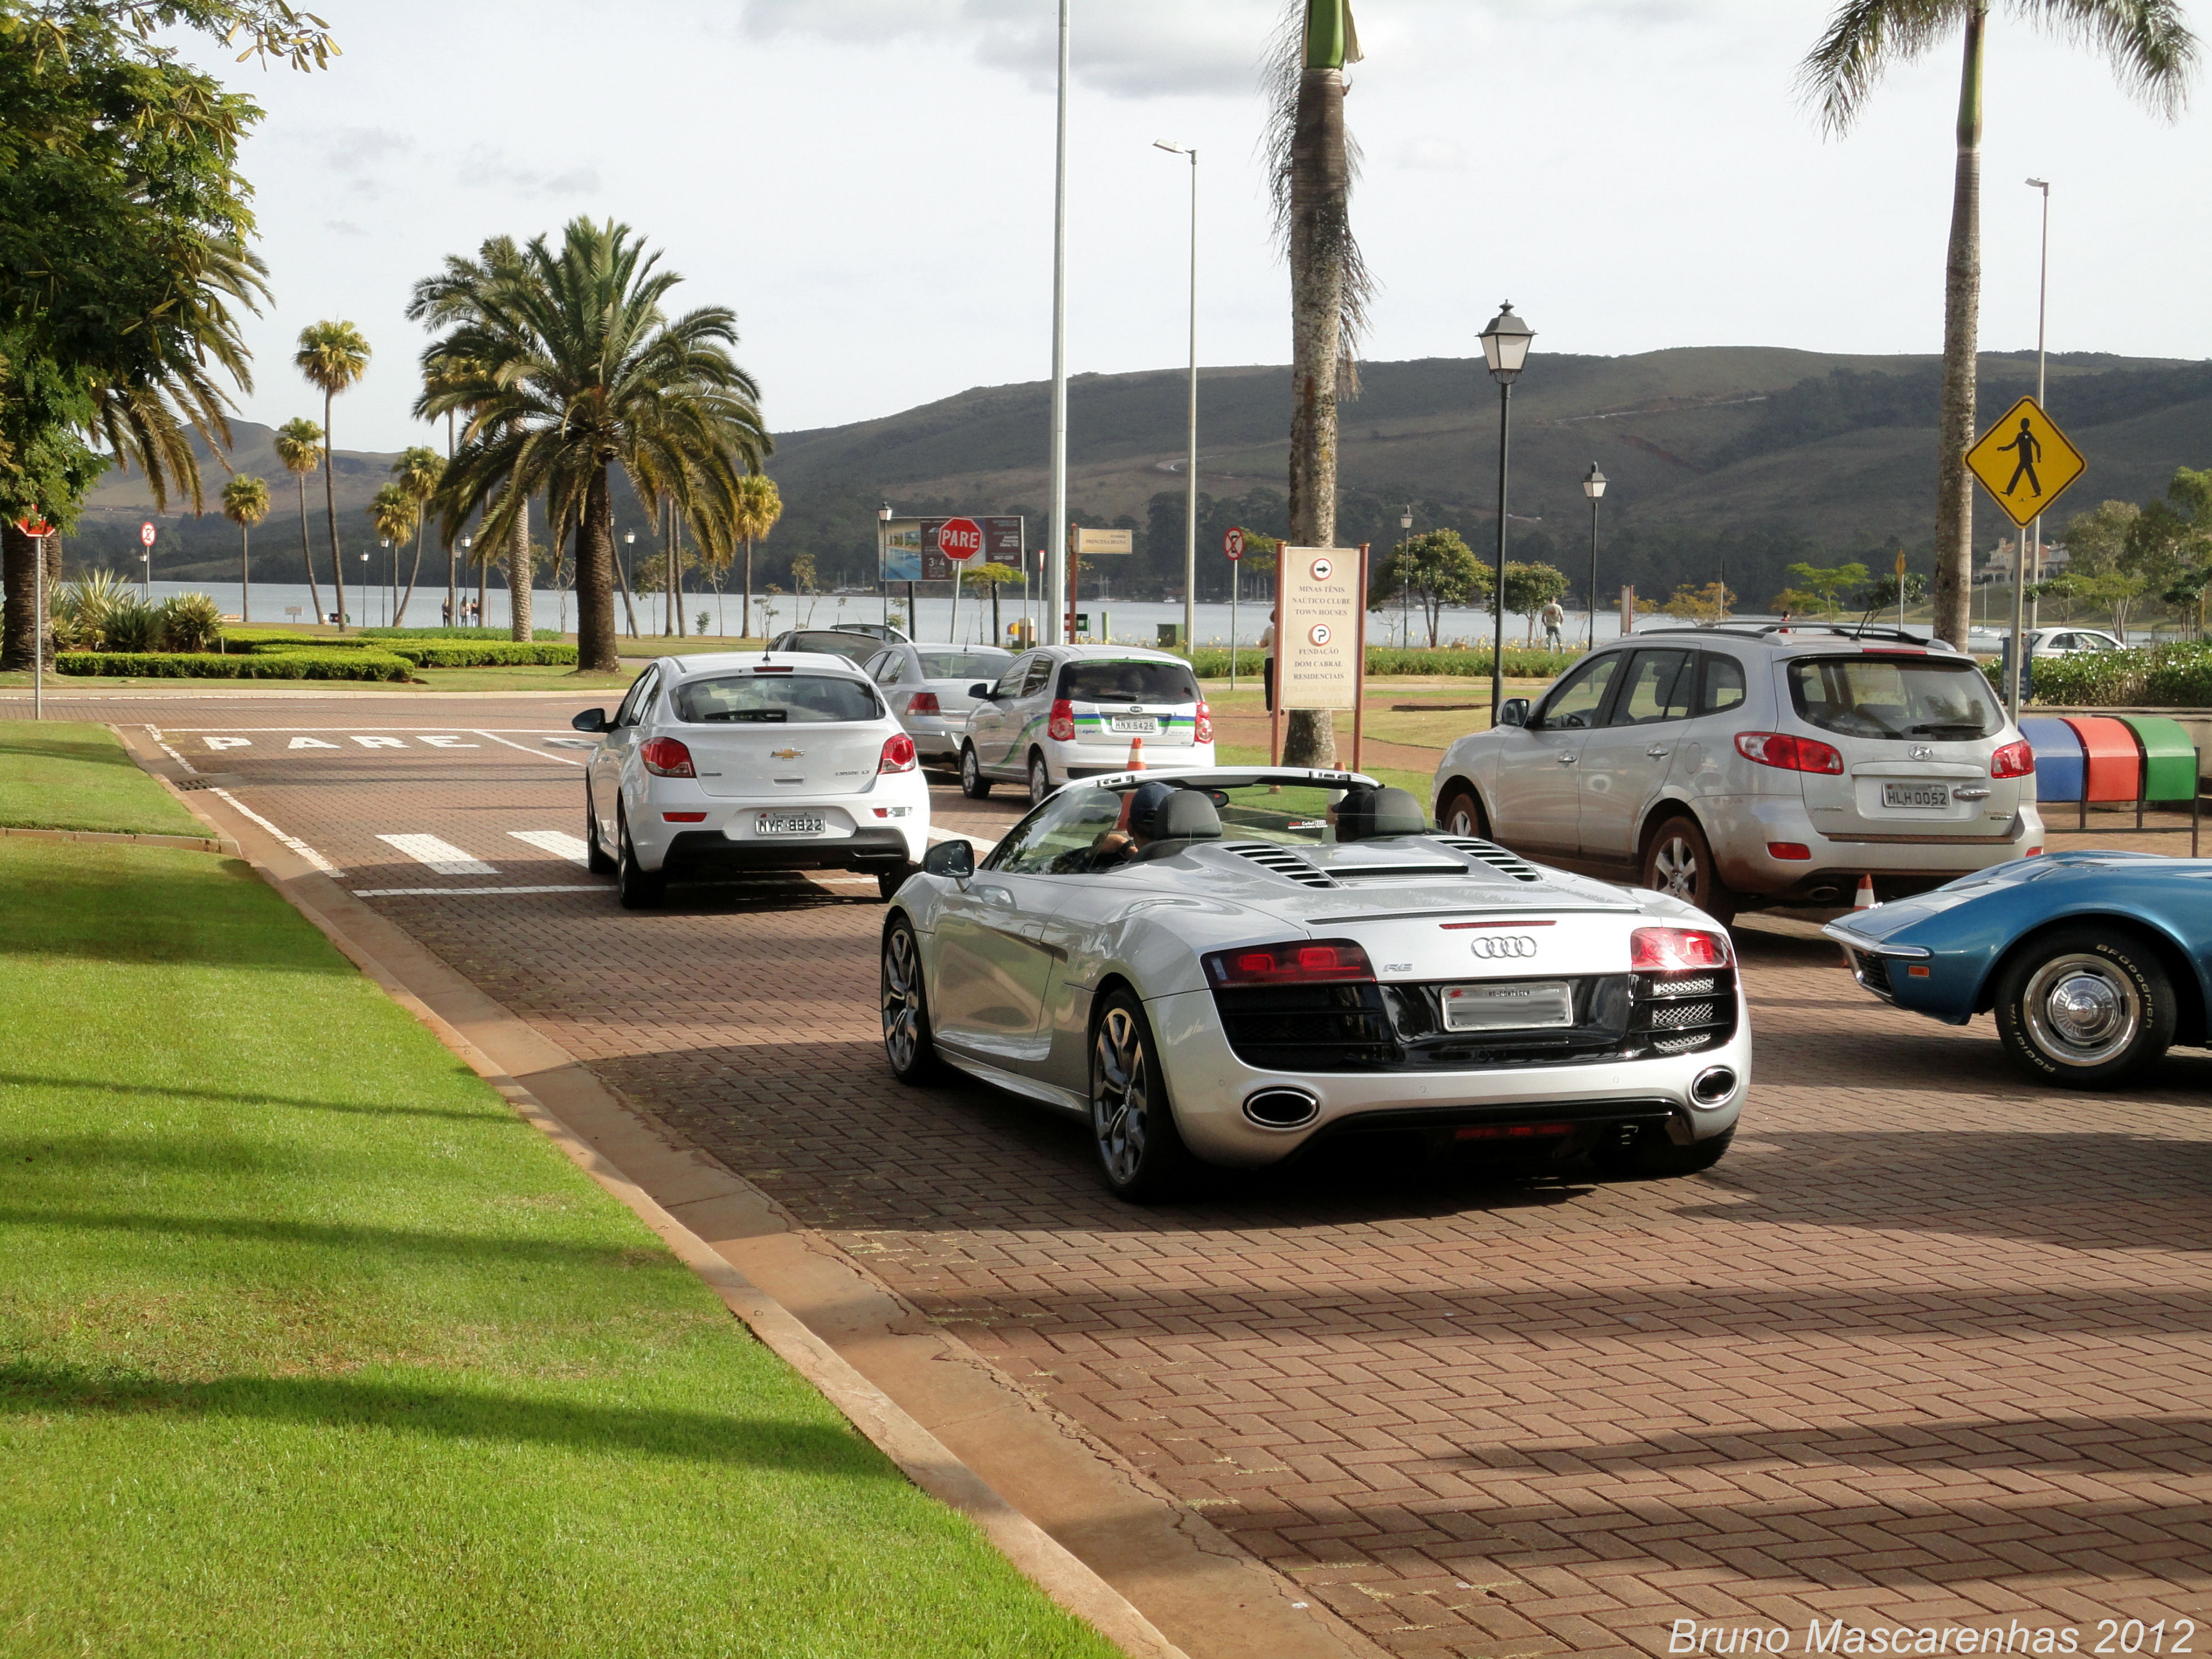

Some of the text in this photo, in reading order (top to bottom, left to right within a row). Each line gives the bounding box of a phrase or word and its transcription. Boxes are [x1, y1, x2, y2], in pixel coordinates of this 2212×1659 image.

[942, 529, 979, 549] PARE
[1324, 585, 1345, 593] TÊNIS
[1299, 647, 1339, 655] FUNDAÇÃO
[1115, 721, 1154, 730] HNX 5425
[202, 735, 479, 750] PARE
[1887, 792, 1947, 805] HLH 0052
[759, 819, 822, 832] NYF 8822
[1383, 963, 1413, 972] R8
[2096, 944, 2153, 1029] BFGoodrich
[2014, 1032, 2056, 1072] Radial
